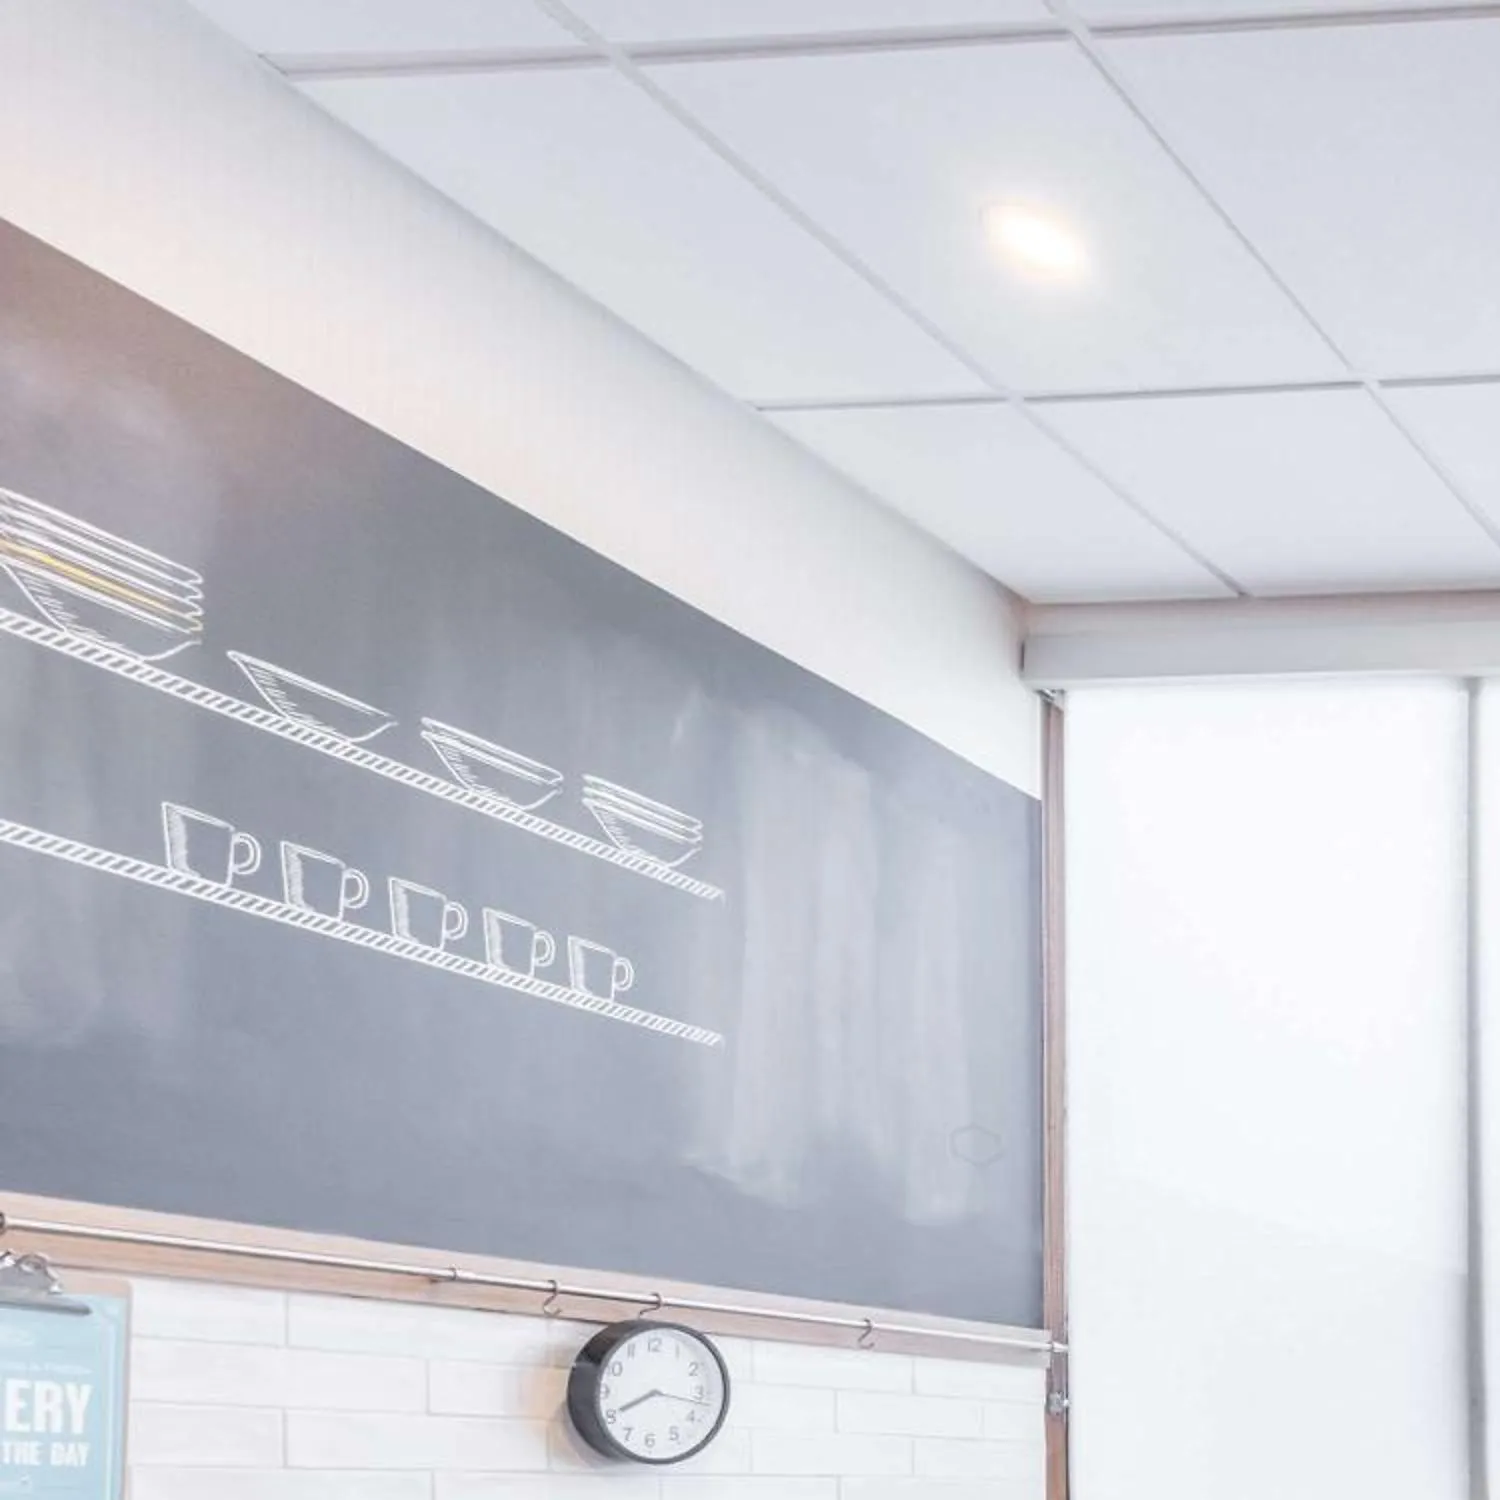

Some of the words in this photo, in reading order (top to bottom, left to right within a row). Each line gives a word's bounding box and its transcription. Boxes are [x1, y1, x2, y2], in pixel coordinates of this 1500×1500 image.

[647, 1338, 662, 1353] 12
[688, 1362, 699, 1377] 2
[606, 1408, 617, 1425] 8
[686, 1409, 697, 1423] 4
[623, 1427, 634, 1442] 7
[644, 1433, 656, 1448] 6
[668, 1426, 680, 1441] 5
[2, 1440, 42, 1466] THE
[50, 1441, 90, 1467] DAY
